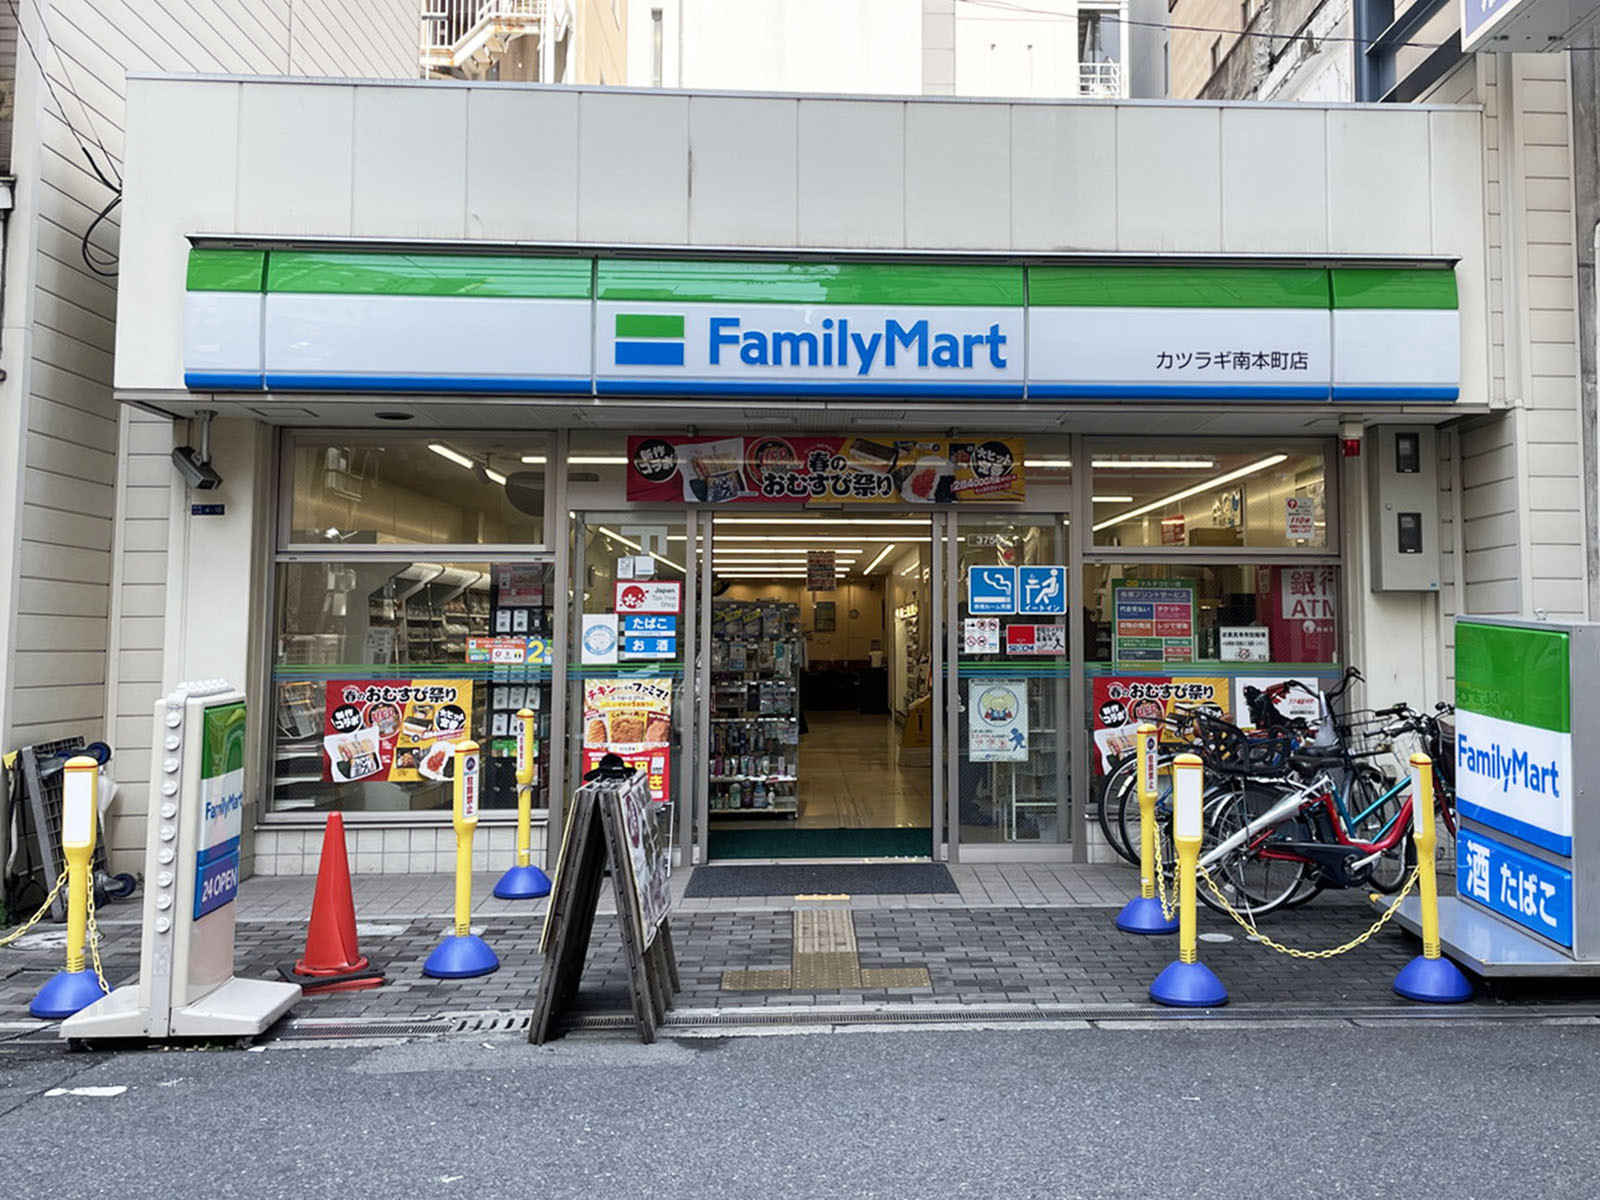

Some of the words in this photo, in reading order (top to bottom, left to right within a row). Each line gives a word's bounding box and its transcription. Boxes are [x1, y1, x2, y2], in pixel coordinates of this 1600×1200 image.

[709, 317, 1007, 376] FamilyMart
[1156, 351, 1309, 370] カツラギ南本町店
[640, 454, 674, 474] コラボ
[808, 451, 847, 472] 春の
[763, 473, 892, 497] おむすび祭り
[632, 617, 668, 630] たばこ
[344, 686, 457, 703] 春のおむすび祭り
[588, 685, 616, 700] チキン
[1110, 682, 1215, 700] 春のおむすび祭り
[335, 714, 359, 729] コラボ
[1103, 711, 1126, 724] コラボ
[1458, 733, 1559, 798] FamilyMart
[649, 774, 663, 789] き
[206, 792, 243, 820] FamilyMart
[202, 878, 214, 902] 24
[214, 866, 237, 896] OPEN
[1467, 840, 1490, 902] 酒
[1500, 862, 1557, 928] たばこ
